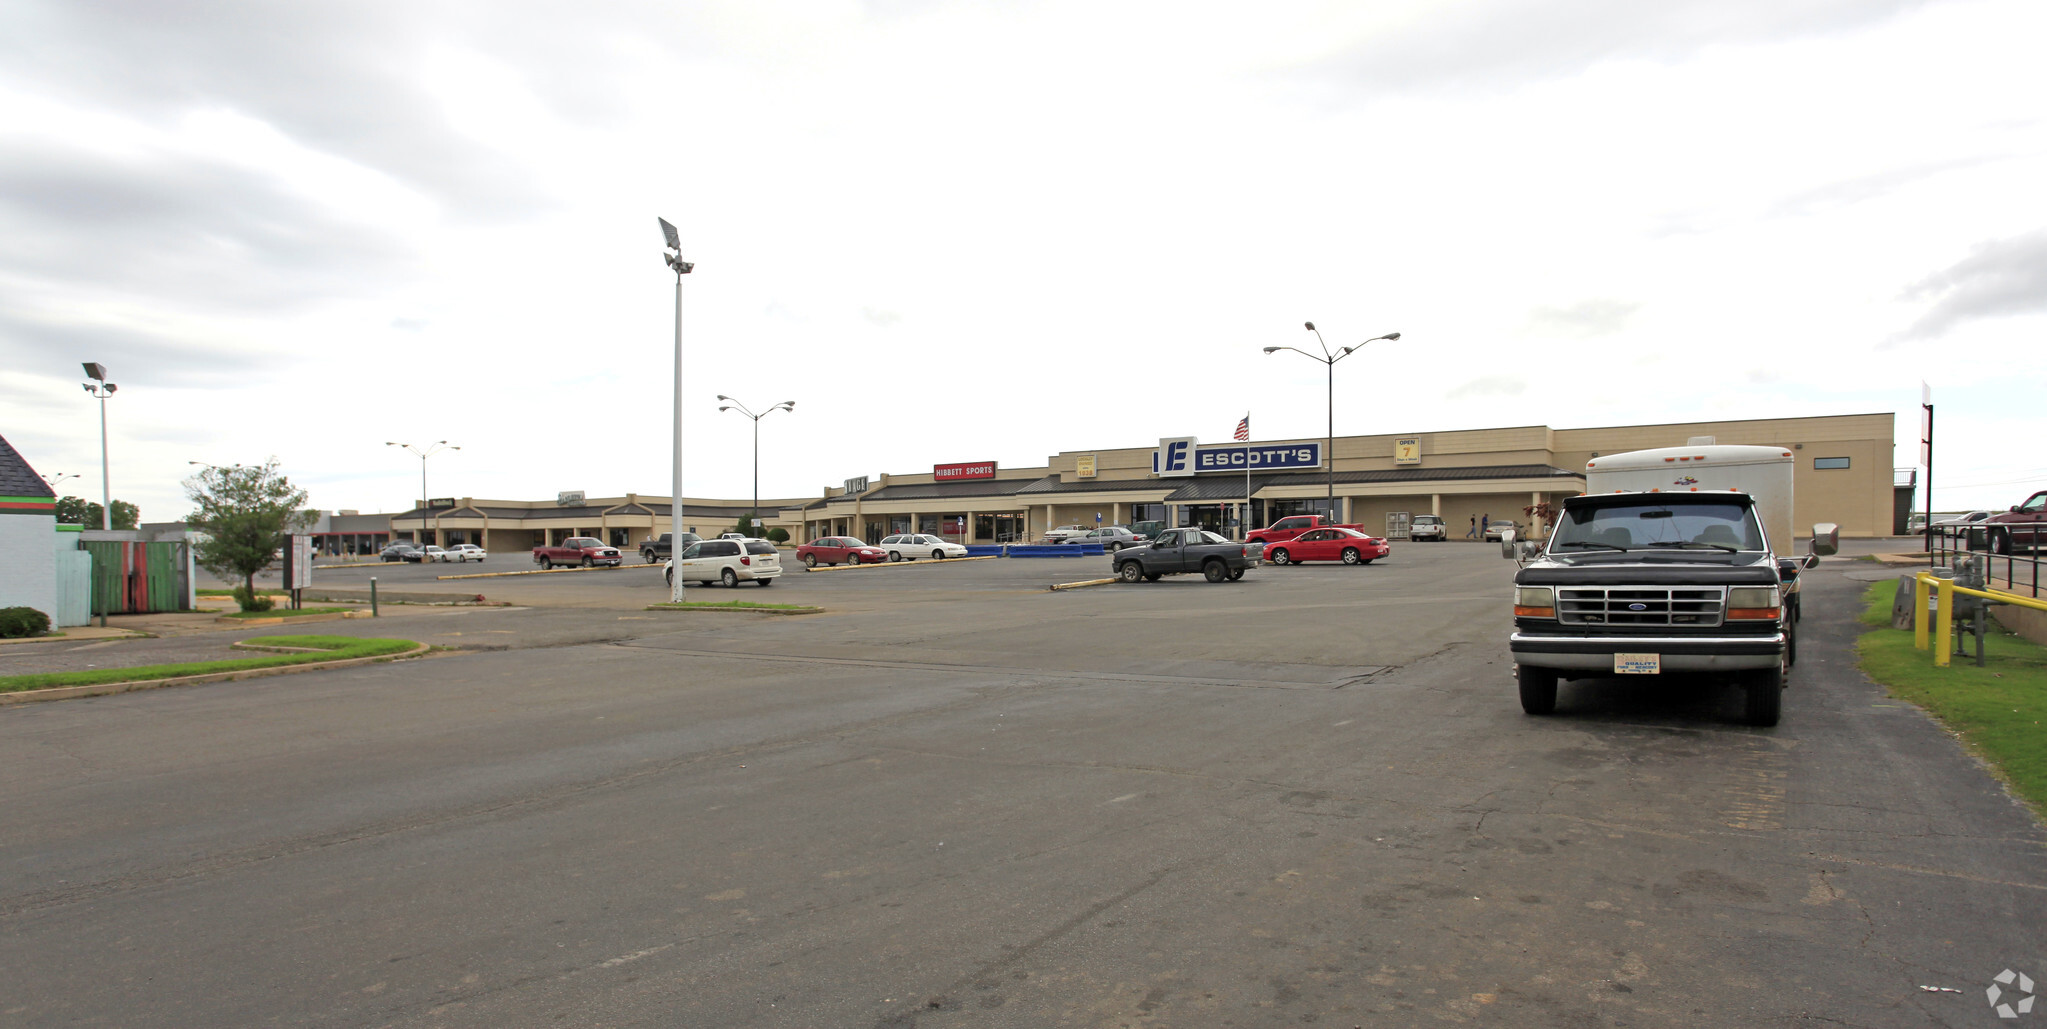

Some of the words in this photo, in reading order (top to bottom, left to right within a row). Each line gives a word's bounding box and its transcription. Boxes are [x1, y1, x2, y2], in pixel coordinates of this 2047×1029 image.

[1202, 449, 1312, 466] ESCOTT'S
[1403, 447, 1411, 457] 7
[936, 468, 962, 477] HIBBETT
[966, 466, 993, 475] SPORTS
